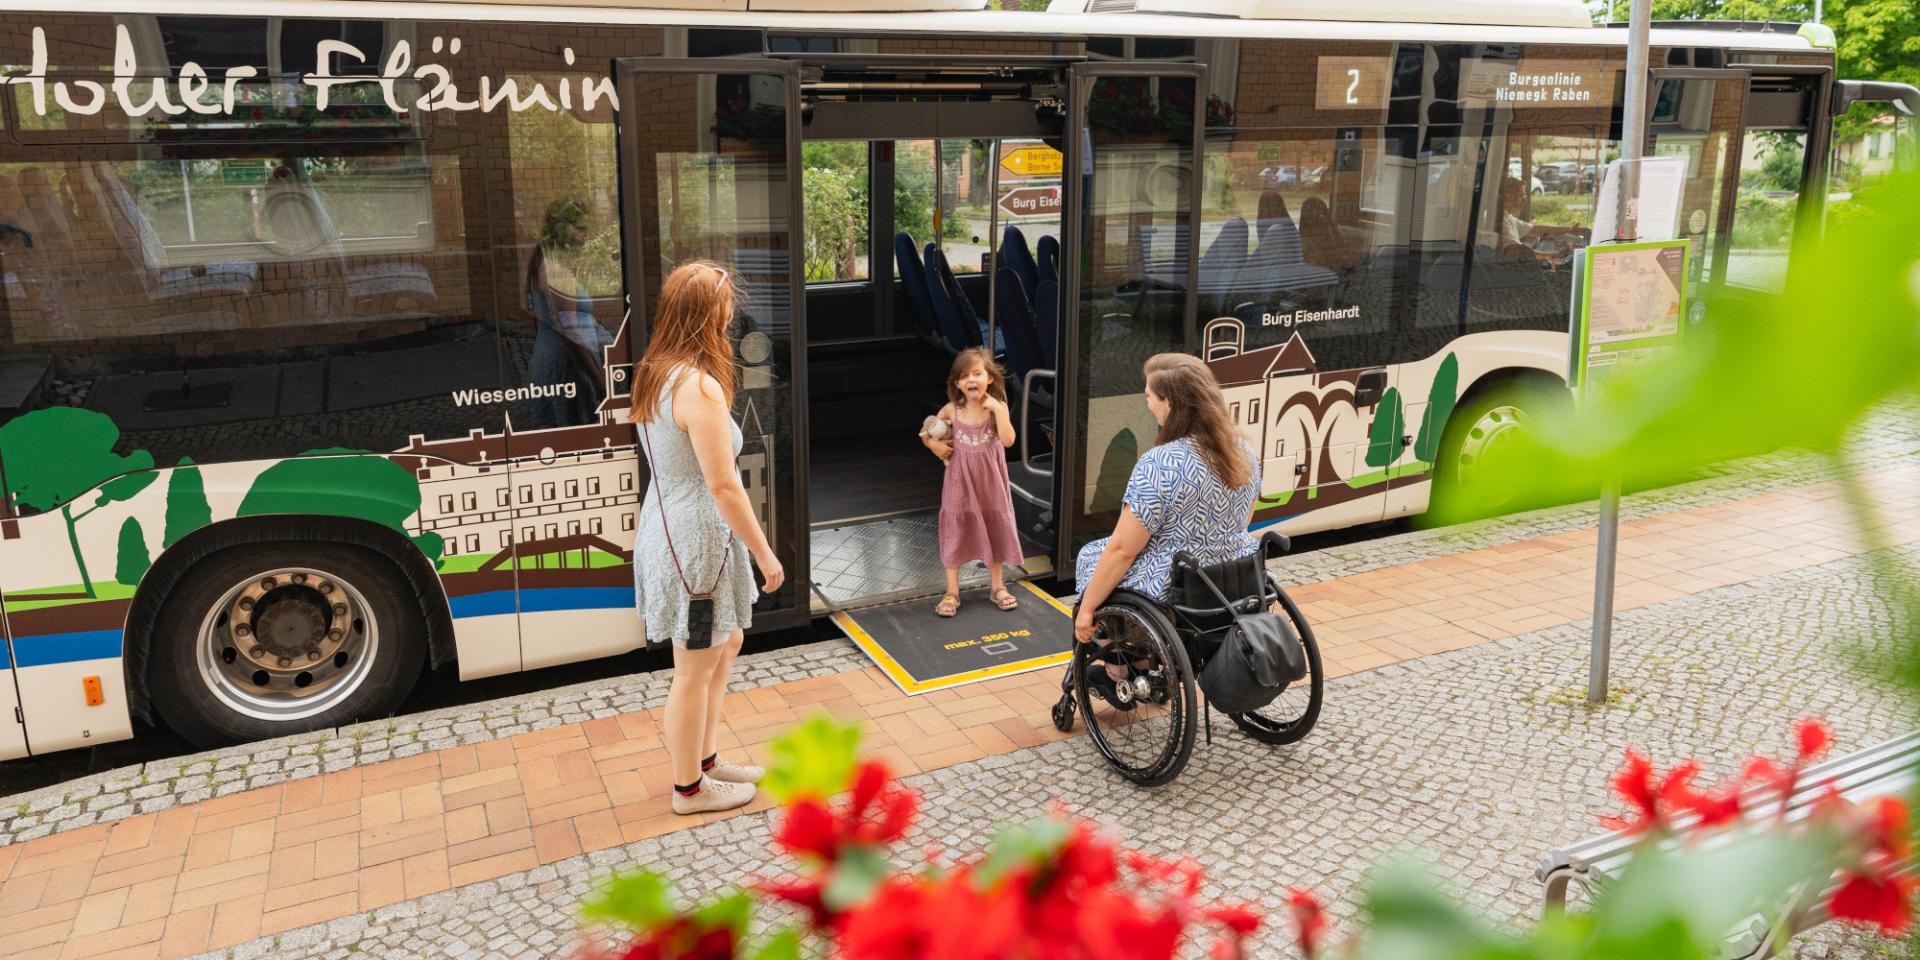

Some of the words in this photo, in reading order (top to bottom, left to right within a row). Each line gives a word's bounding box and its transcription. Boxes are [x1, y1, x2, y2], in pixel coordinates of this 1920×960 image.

[1346, 69, 1359, 104] 2
[1509, 72, 1581, 86] Burgenlinie
[1496, 88, 1547, 101] Niemegk
[1553, 88, 1590, 101] Raben
[1028, 163, 1051, 172] Borne
[1013, 198, 1036, 210] Burg
[1262, 313, 1292, 327] Burg
[1295, 305, 1360, 323] Eisenhardt
[452, 382, 577, 407] Wiesenburg
[943, 640, 982, 650] max.
[981, 632, 1009, 643] 350
[1009, 629, 1032, 638] kg
